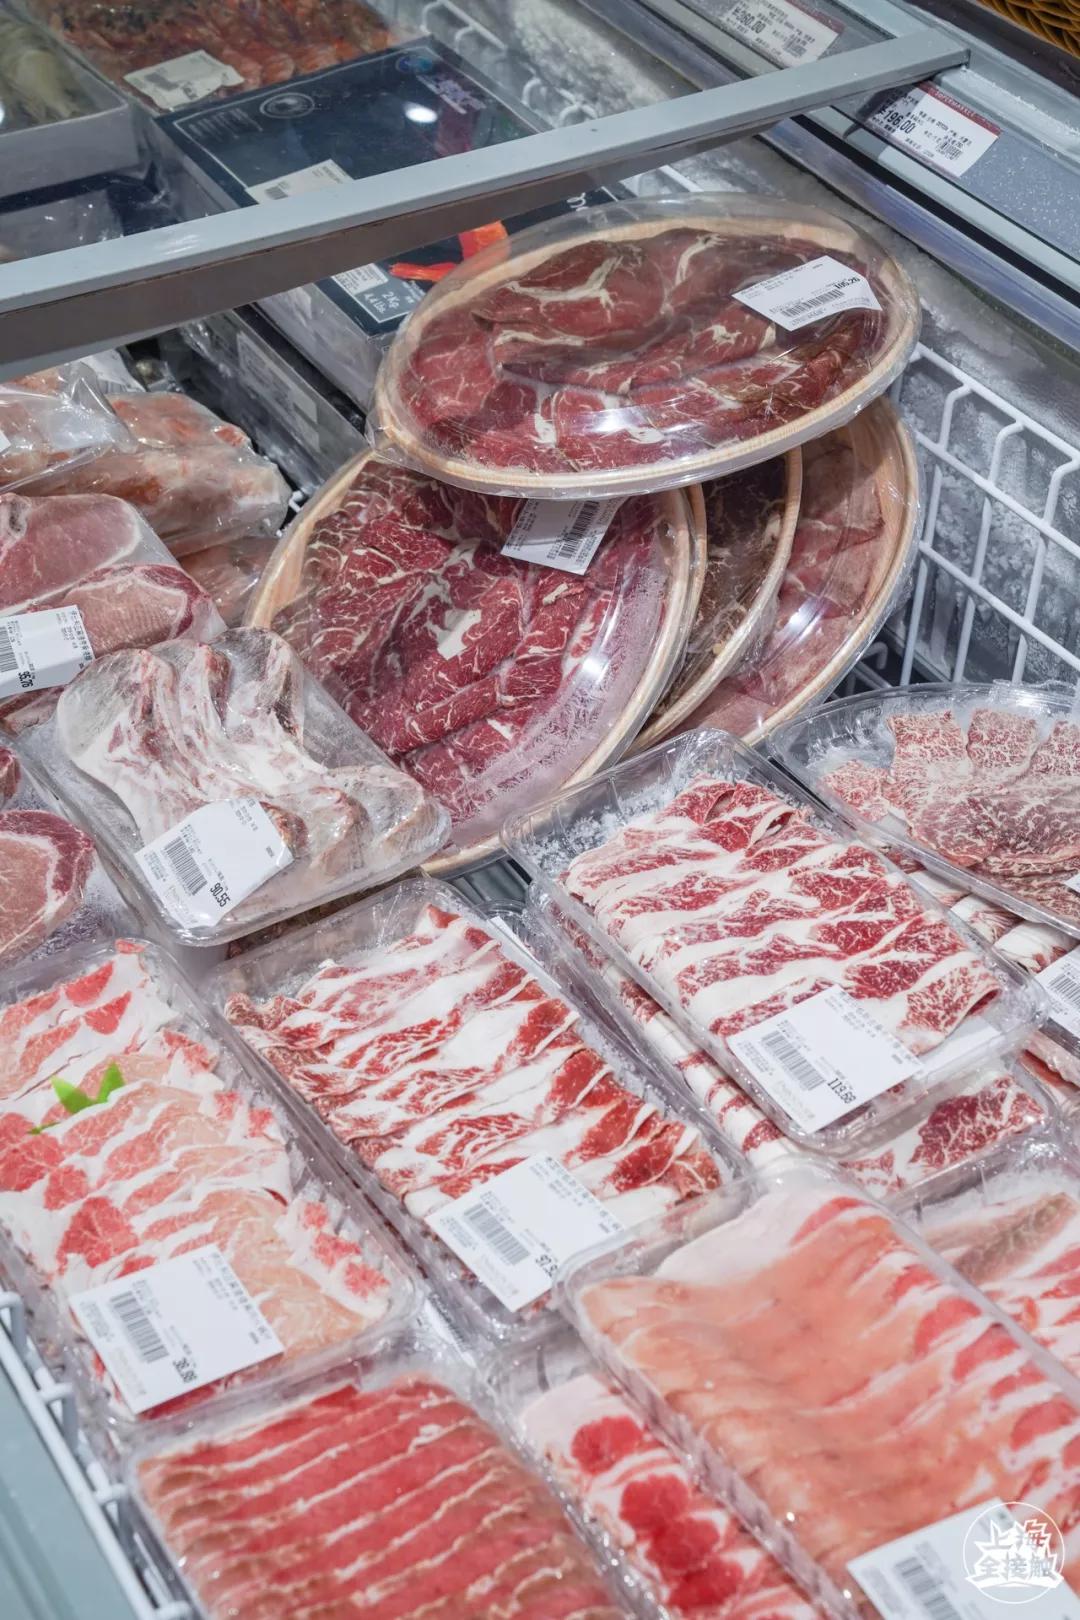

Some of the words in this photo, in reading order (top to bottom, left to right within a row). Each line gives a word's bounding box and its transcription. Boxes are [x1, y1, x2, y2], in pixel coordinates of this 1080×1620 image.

[880, 104, 916, 134] ¥196.00
[209, 882, 231, 907] 90.55
[826, 1077, 856, 1104] 119.68
